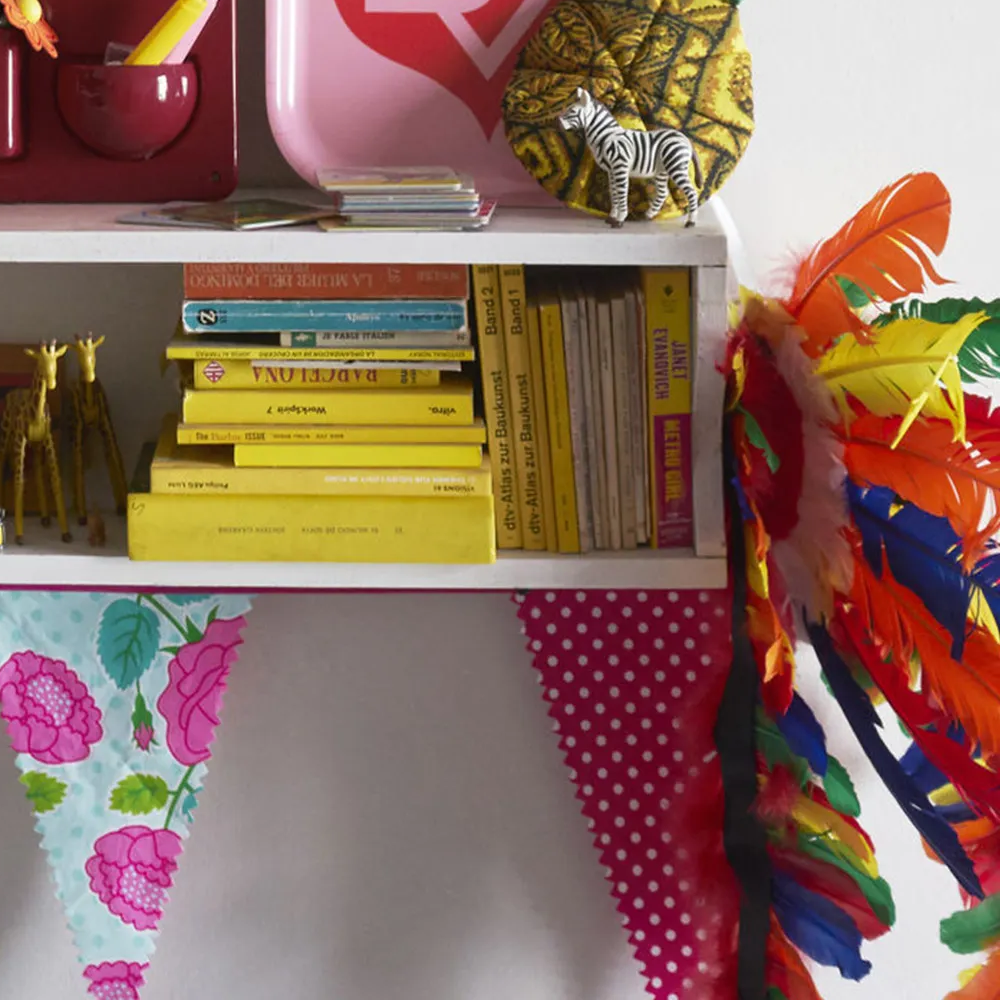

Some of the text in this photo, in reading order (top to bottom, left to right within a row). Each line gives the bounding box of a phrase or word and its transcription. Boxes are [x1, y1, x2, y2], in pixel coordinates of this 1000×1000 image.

[189, 273, 260, 288] DOMINGO
[481, 287, 494, 295] 2
[484, 299, 498, 335] Band
[508, 299, 523, 335] Band
[653, 327, 669, 400] EVANOVICH
[671, 340, 688, 380] JANET
[491, 370, 517, 531] dtv-Atlas zur Baukunst
[516, 373, 541, 534] dtv-Atlas zur Baukunst
